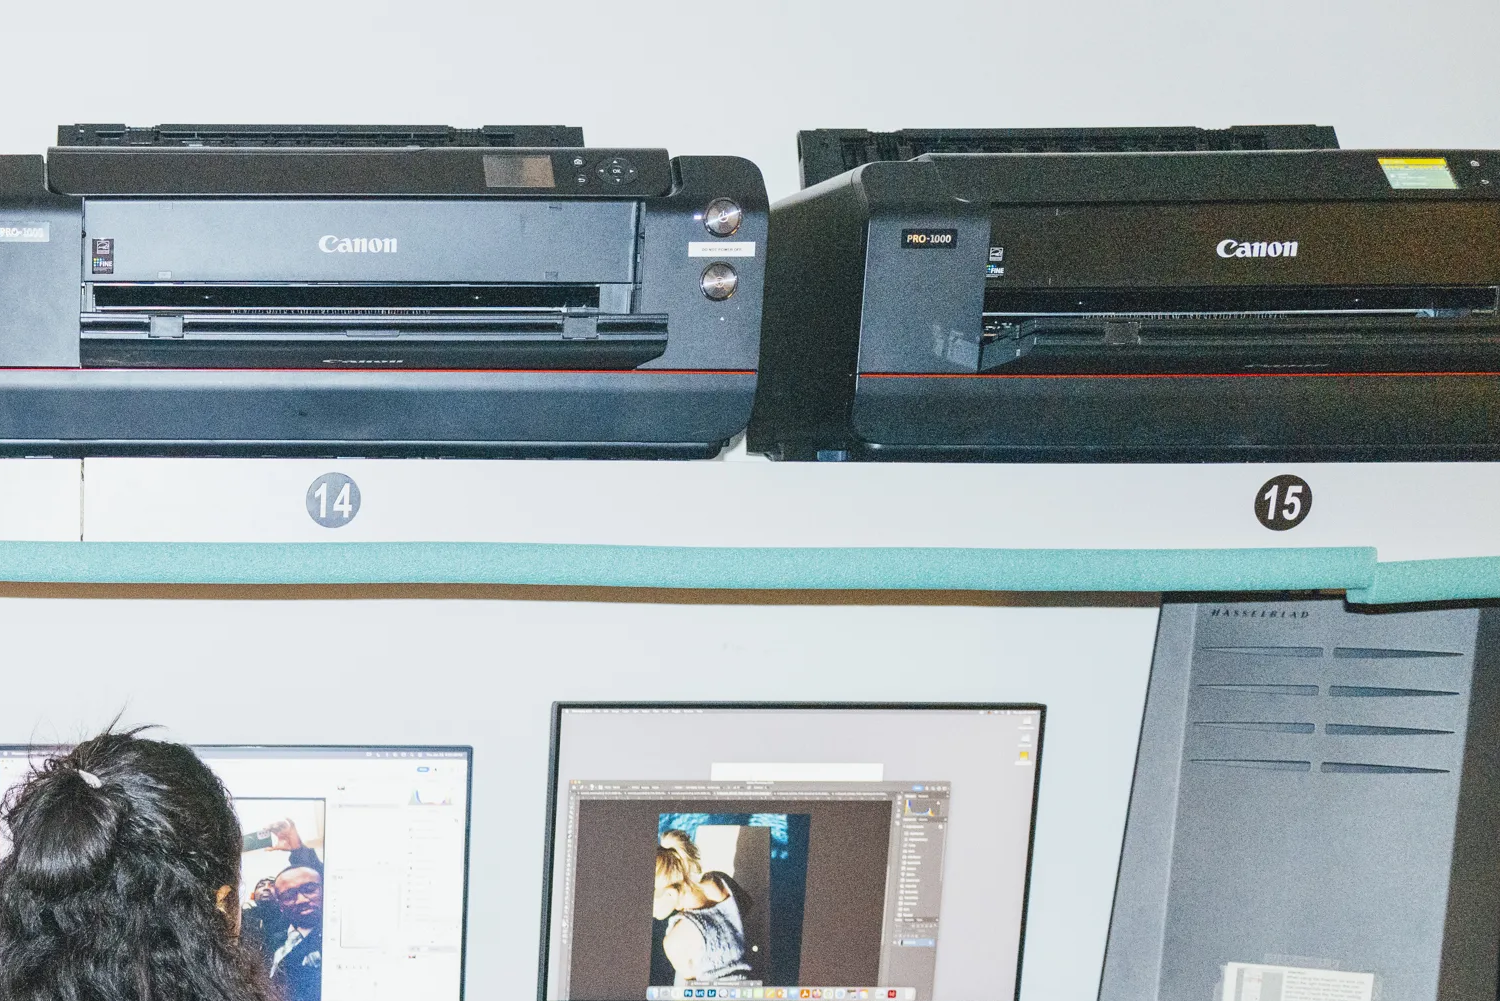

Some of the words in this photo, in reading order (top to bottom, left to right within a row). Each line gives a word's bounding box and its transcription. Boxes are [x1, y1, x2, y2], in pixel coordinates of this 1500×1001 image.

[318, 234, 397, 253] Canon
[906, 234, 952, 243] PRO-1000
[1216, 239, 1298, 258] Canon
[314, 482, 352, 518] 14
[1264, 484, 1302, 520] 15
